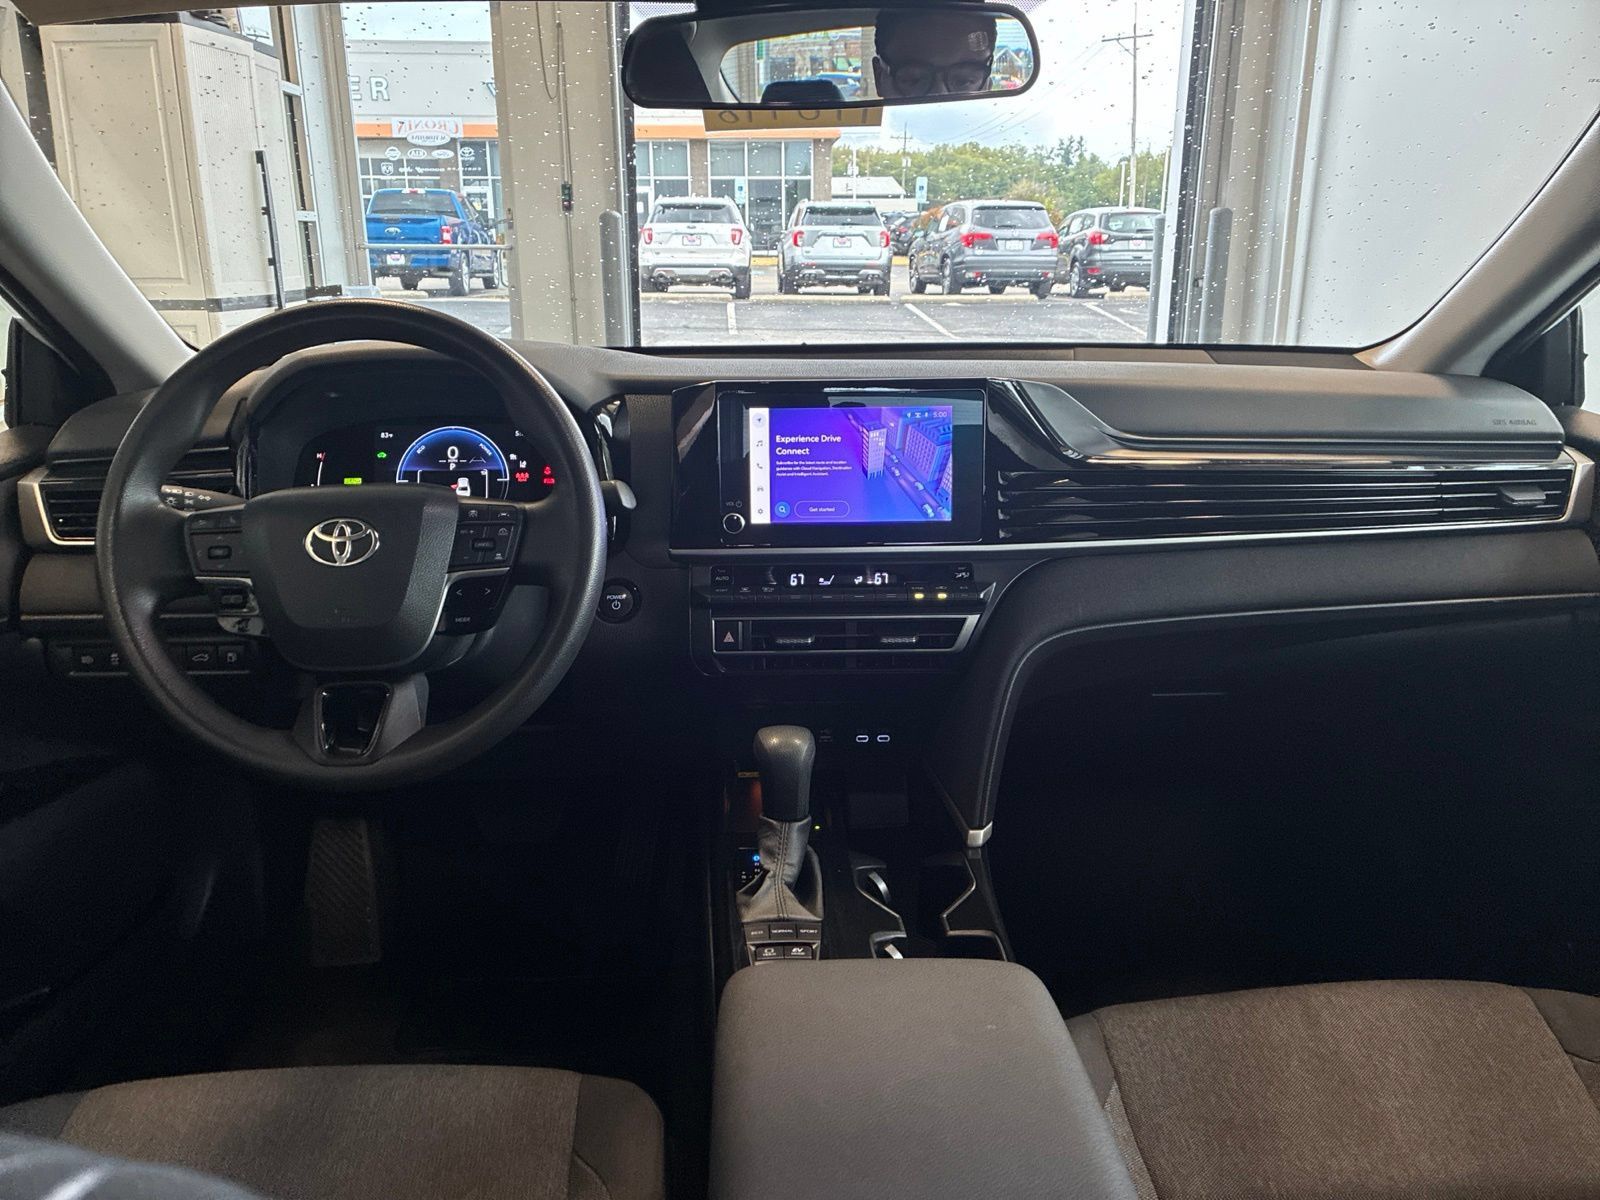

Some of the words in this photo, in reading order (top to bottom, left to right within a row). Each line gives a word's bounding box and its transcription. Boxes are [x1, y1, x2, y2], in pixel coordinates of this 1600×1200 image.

[775, 434, 819, 444] Experience
[820, 434, 842, 443] Drive
[775, 447, 810, 456] Connect
[790, 573, 805, 586] 67
[874, 572, 889, 585] 67
